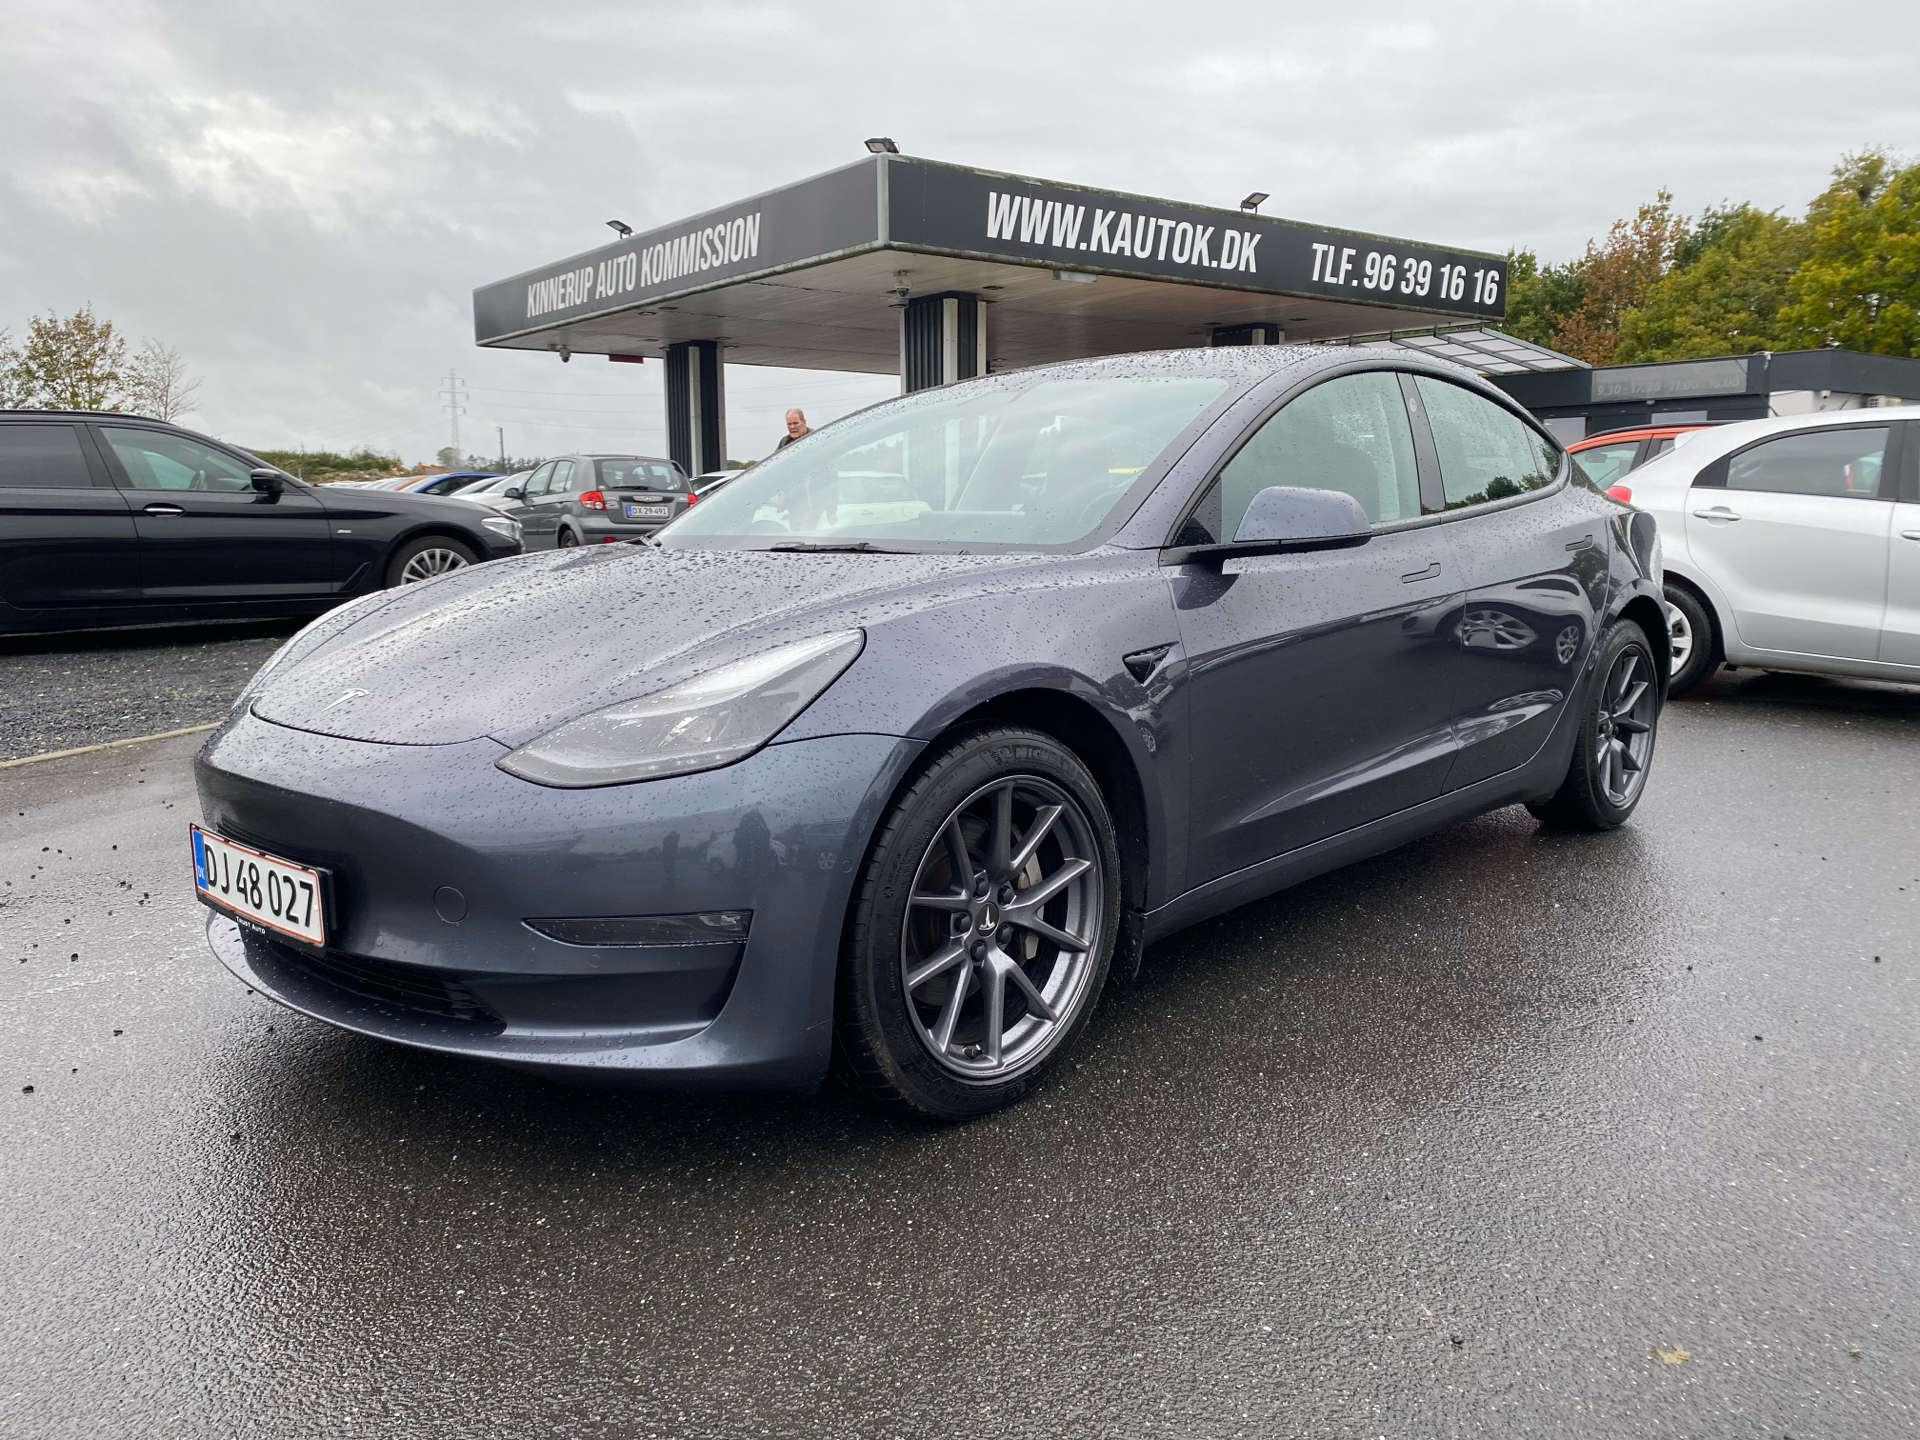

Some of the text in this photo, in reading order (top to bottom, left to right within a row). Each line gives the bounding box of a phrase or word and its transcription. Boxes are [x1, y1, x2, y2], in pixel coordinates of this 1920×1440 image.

[527, 212, 761, 318] KINNERUP AUTO KOMMISSION
[987, 191, 1262, 273] WWW.KAUTOK.DK
[1312, 243, 1500, 305] TLF. 96 39 16 16
[1597, 384, 1622, 396] 9.30
[632, 507, 667, 515] DX 29 491
[204, 843, 313, 928] DJ 48 027
